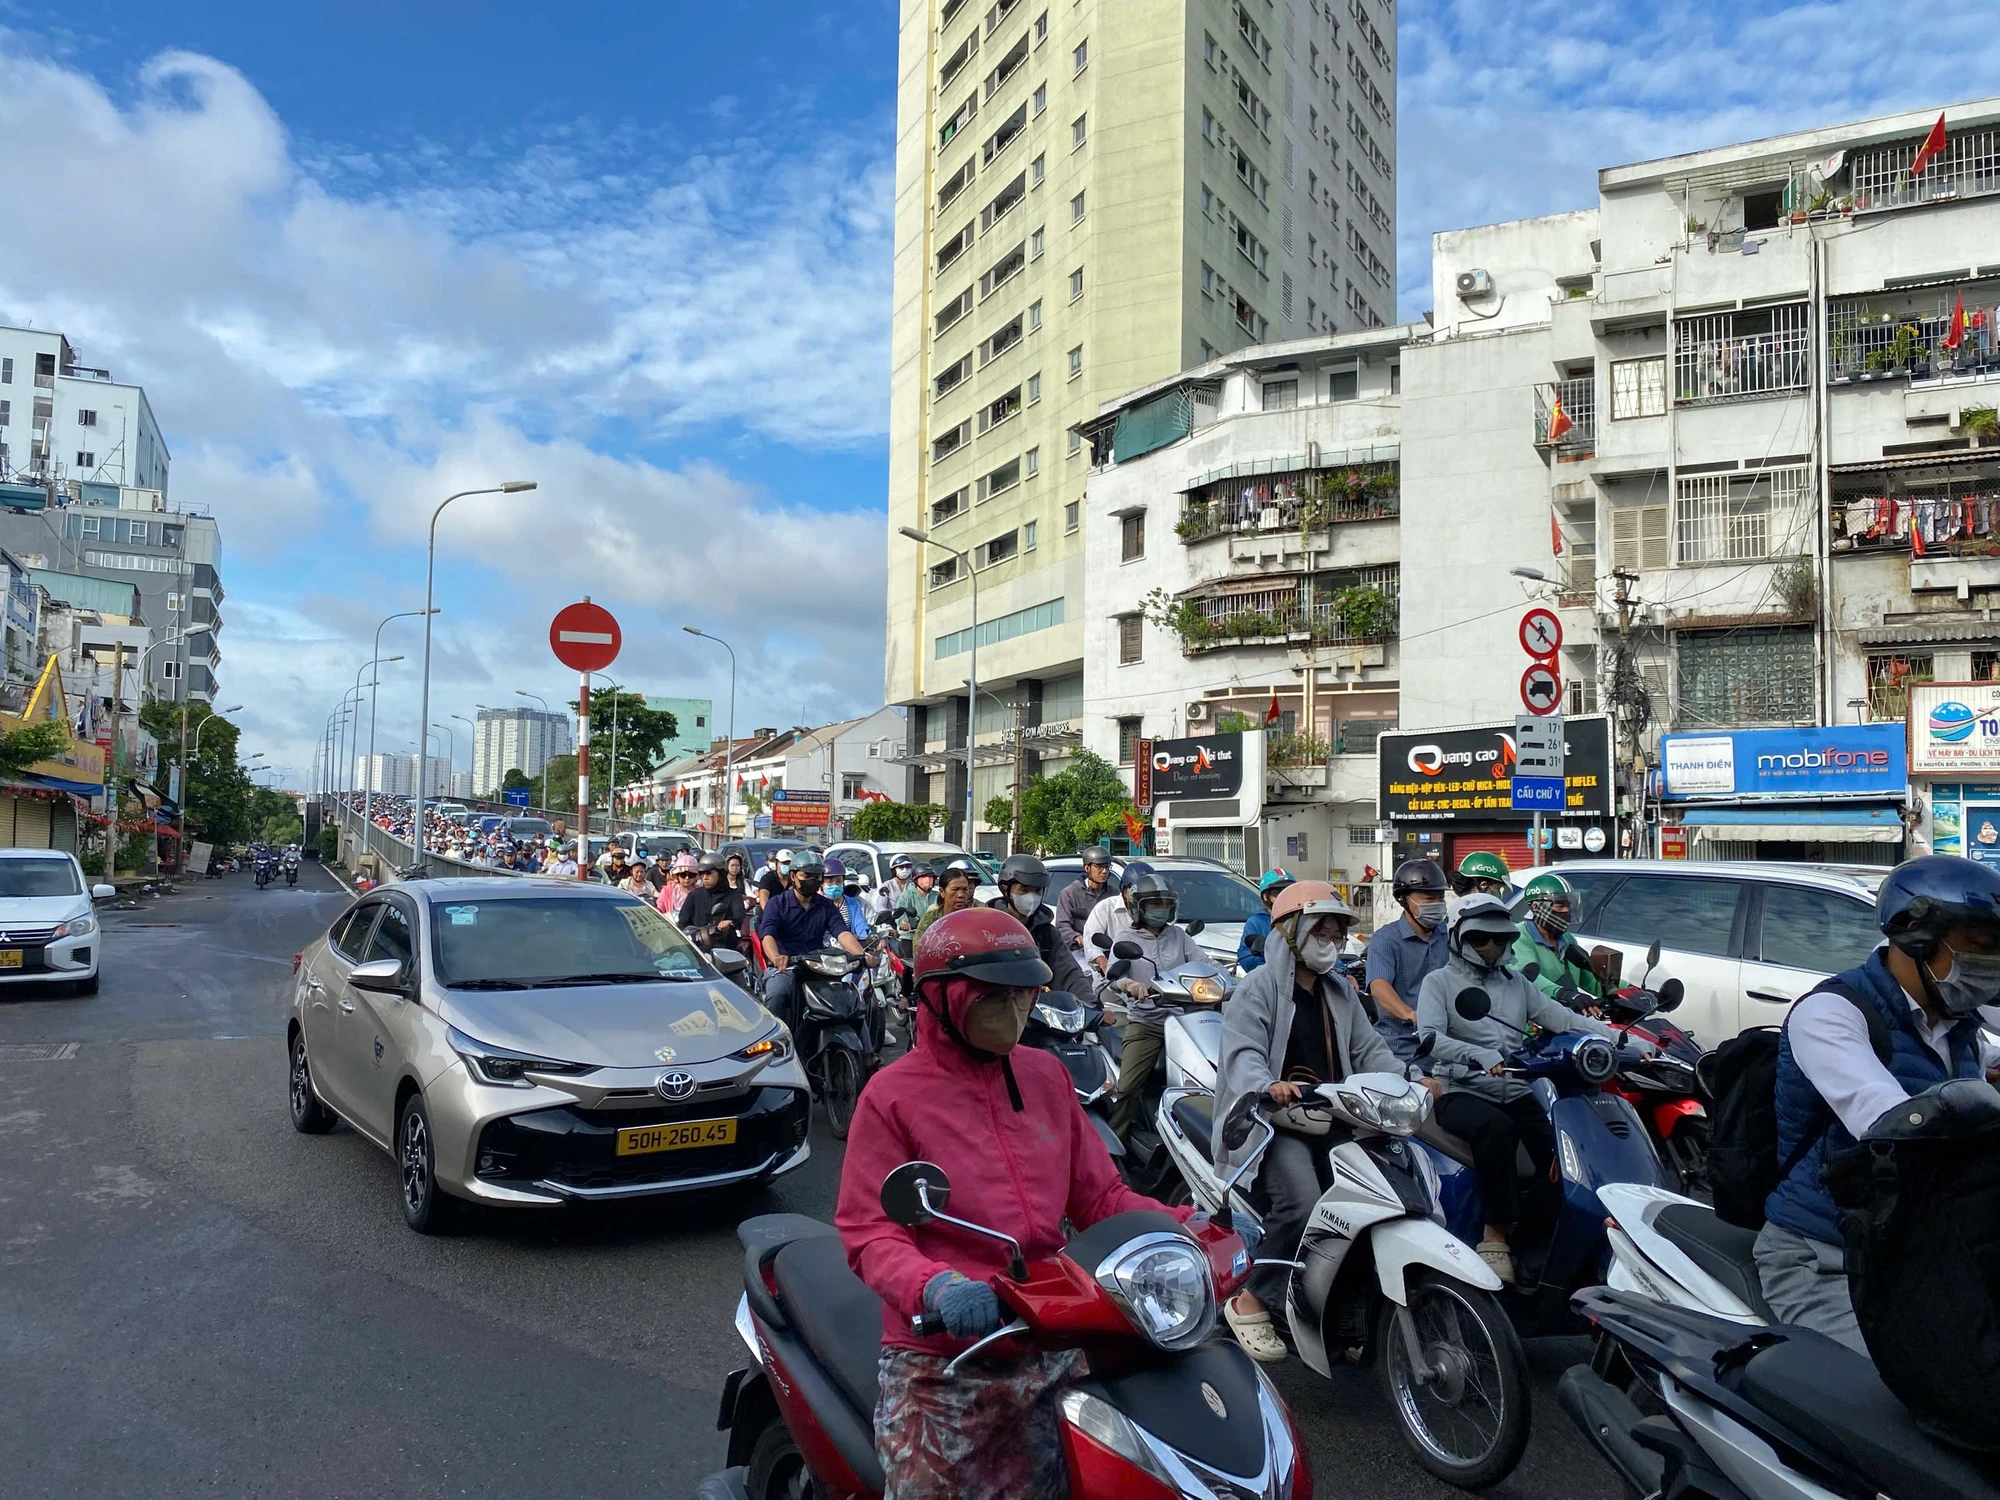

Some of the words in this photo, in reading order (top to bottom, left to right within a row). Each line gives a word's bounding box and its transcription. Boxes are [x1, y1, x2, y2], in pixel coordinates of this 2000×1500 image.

[1153, 752, 1185, 772] Quang
[1186, 754, 1198, 763] cao
[1408, 744, 1473, 776] Quang
[1475, 749, 1498, 762] cao
[1670, 761, 1704, 770] THANH
[1758, 747, 1889, 769] mobifone
[1555, 790, 1561, 800] Y
[1476, 864, 1498, 874] Grab
[1526, 886, 1540, 896] Grab
[628, 1124, 728, 1150] 50H-260.45
[1320, 1207, 1350, 1232] YAMAHA
